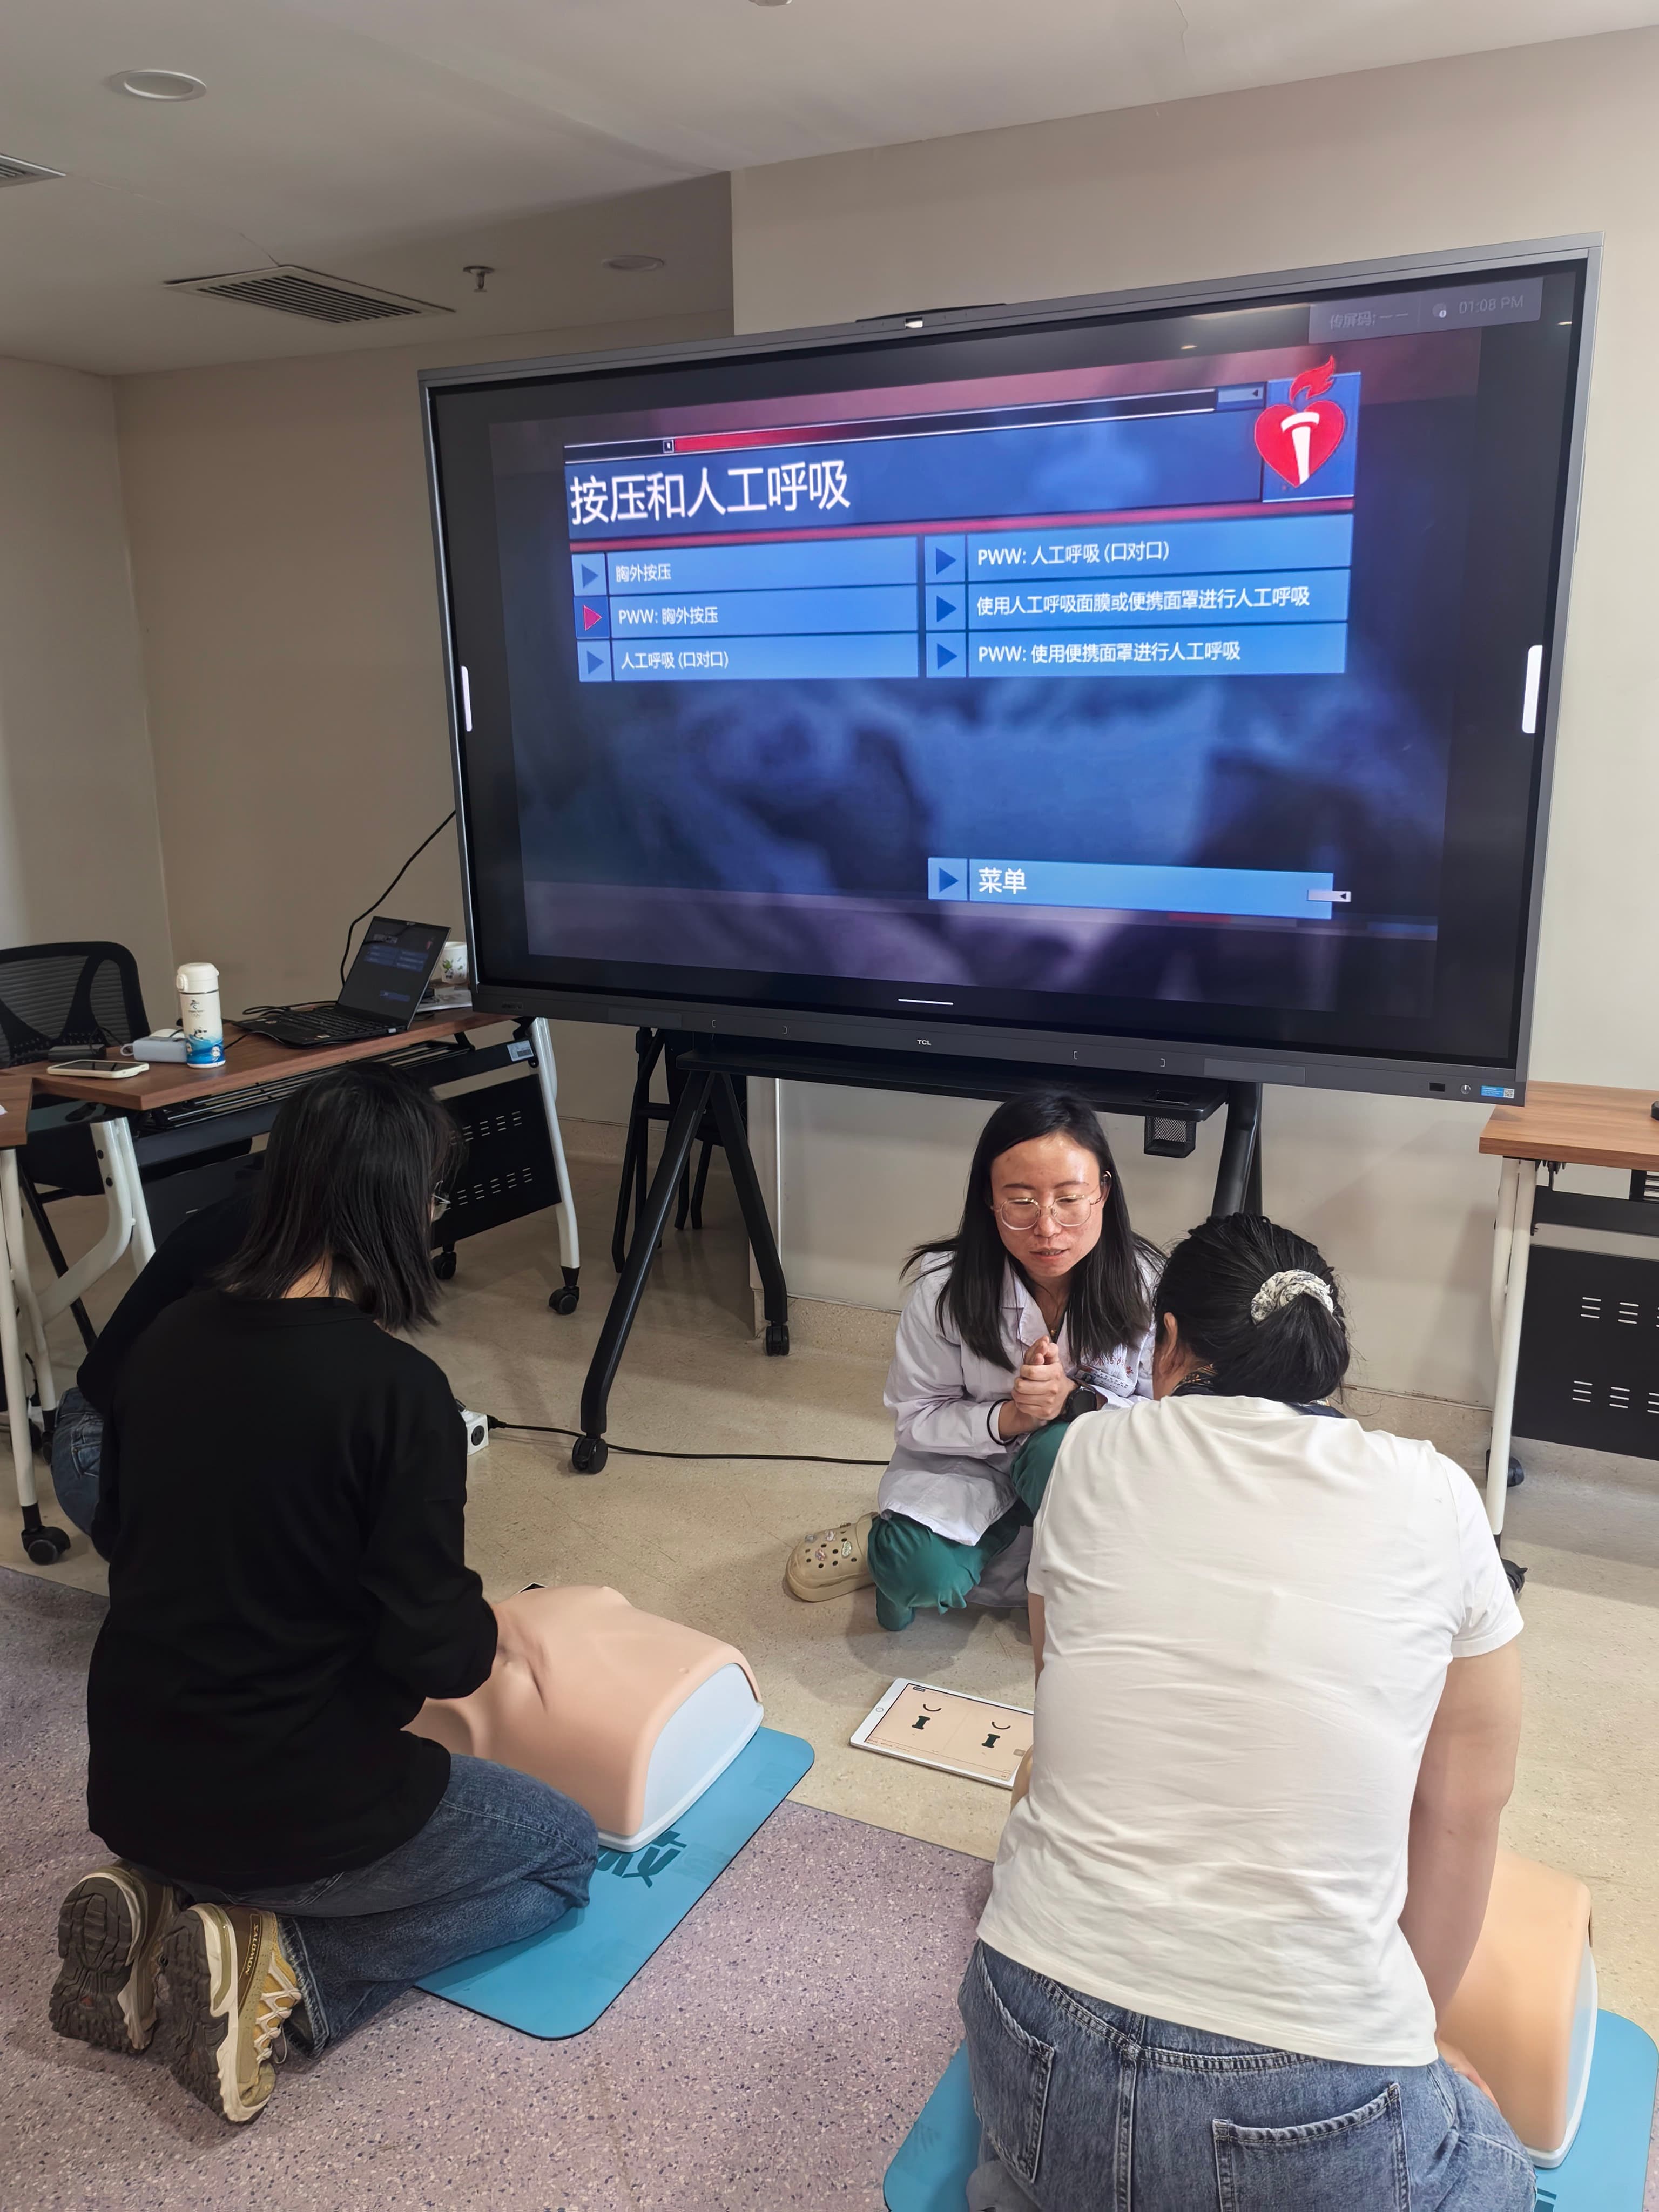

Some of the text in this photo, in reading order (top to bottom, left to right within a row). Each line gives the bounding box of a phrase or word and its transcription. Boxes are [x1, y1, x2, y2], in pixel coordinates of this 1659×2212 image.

[1459, 295, 1524, 314] 01:08 PM
[570, 460, 851, 525] 按压和人工呼吸
[977, 541, 1170, 565] PWW: 人工呼吸 (口对口)
[616, 563, 671, 582] 胸外按压
[976, 585, 1310, 616] 使用人工呼吸面膜或便携面罩进行人工呼吸
[618, 606, 718, 625] PWW: 胸外按压
[621, 651, 729, 670] 人工呼吸 (口对口)
[978, 641, 1241, 664] PWW: 使用便携面罩进行人工呼吸
[978, 867, 1027, 895] 菜单
